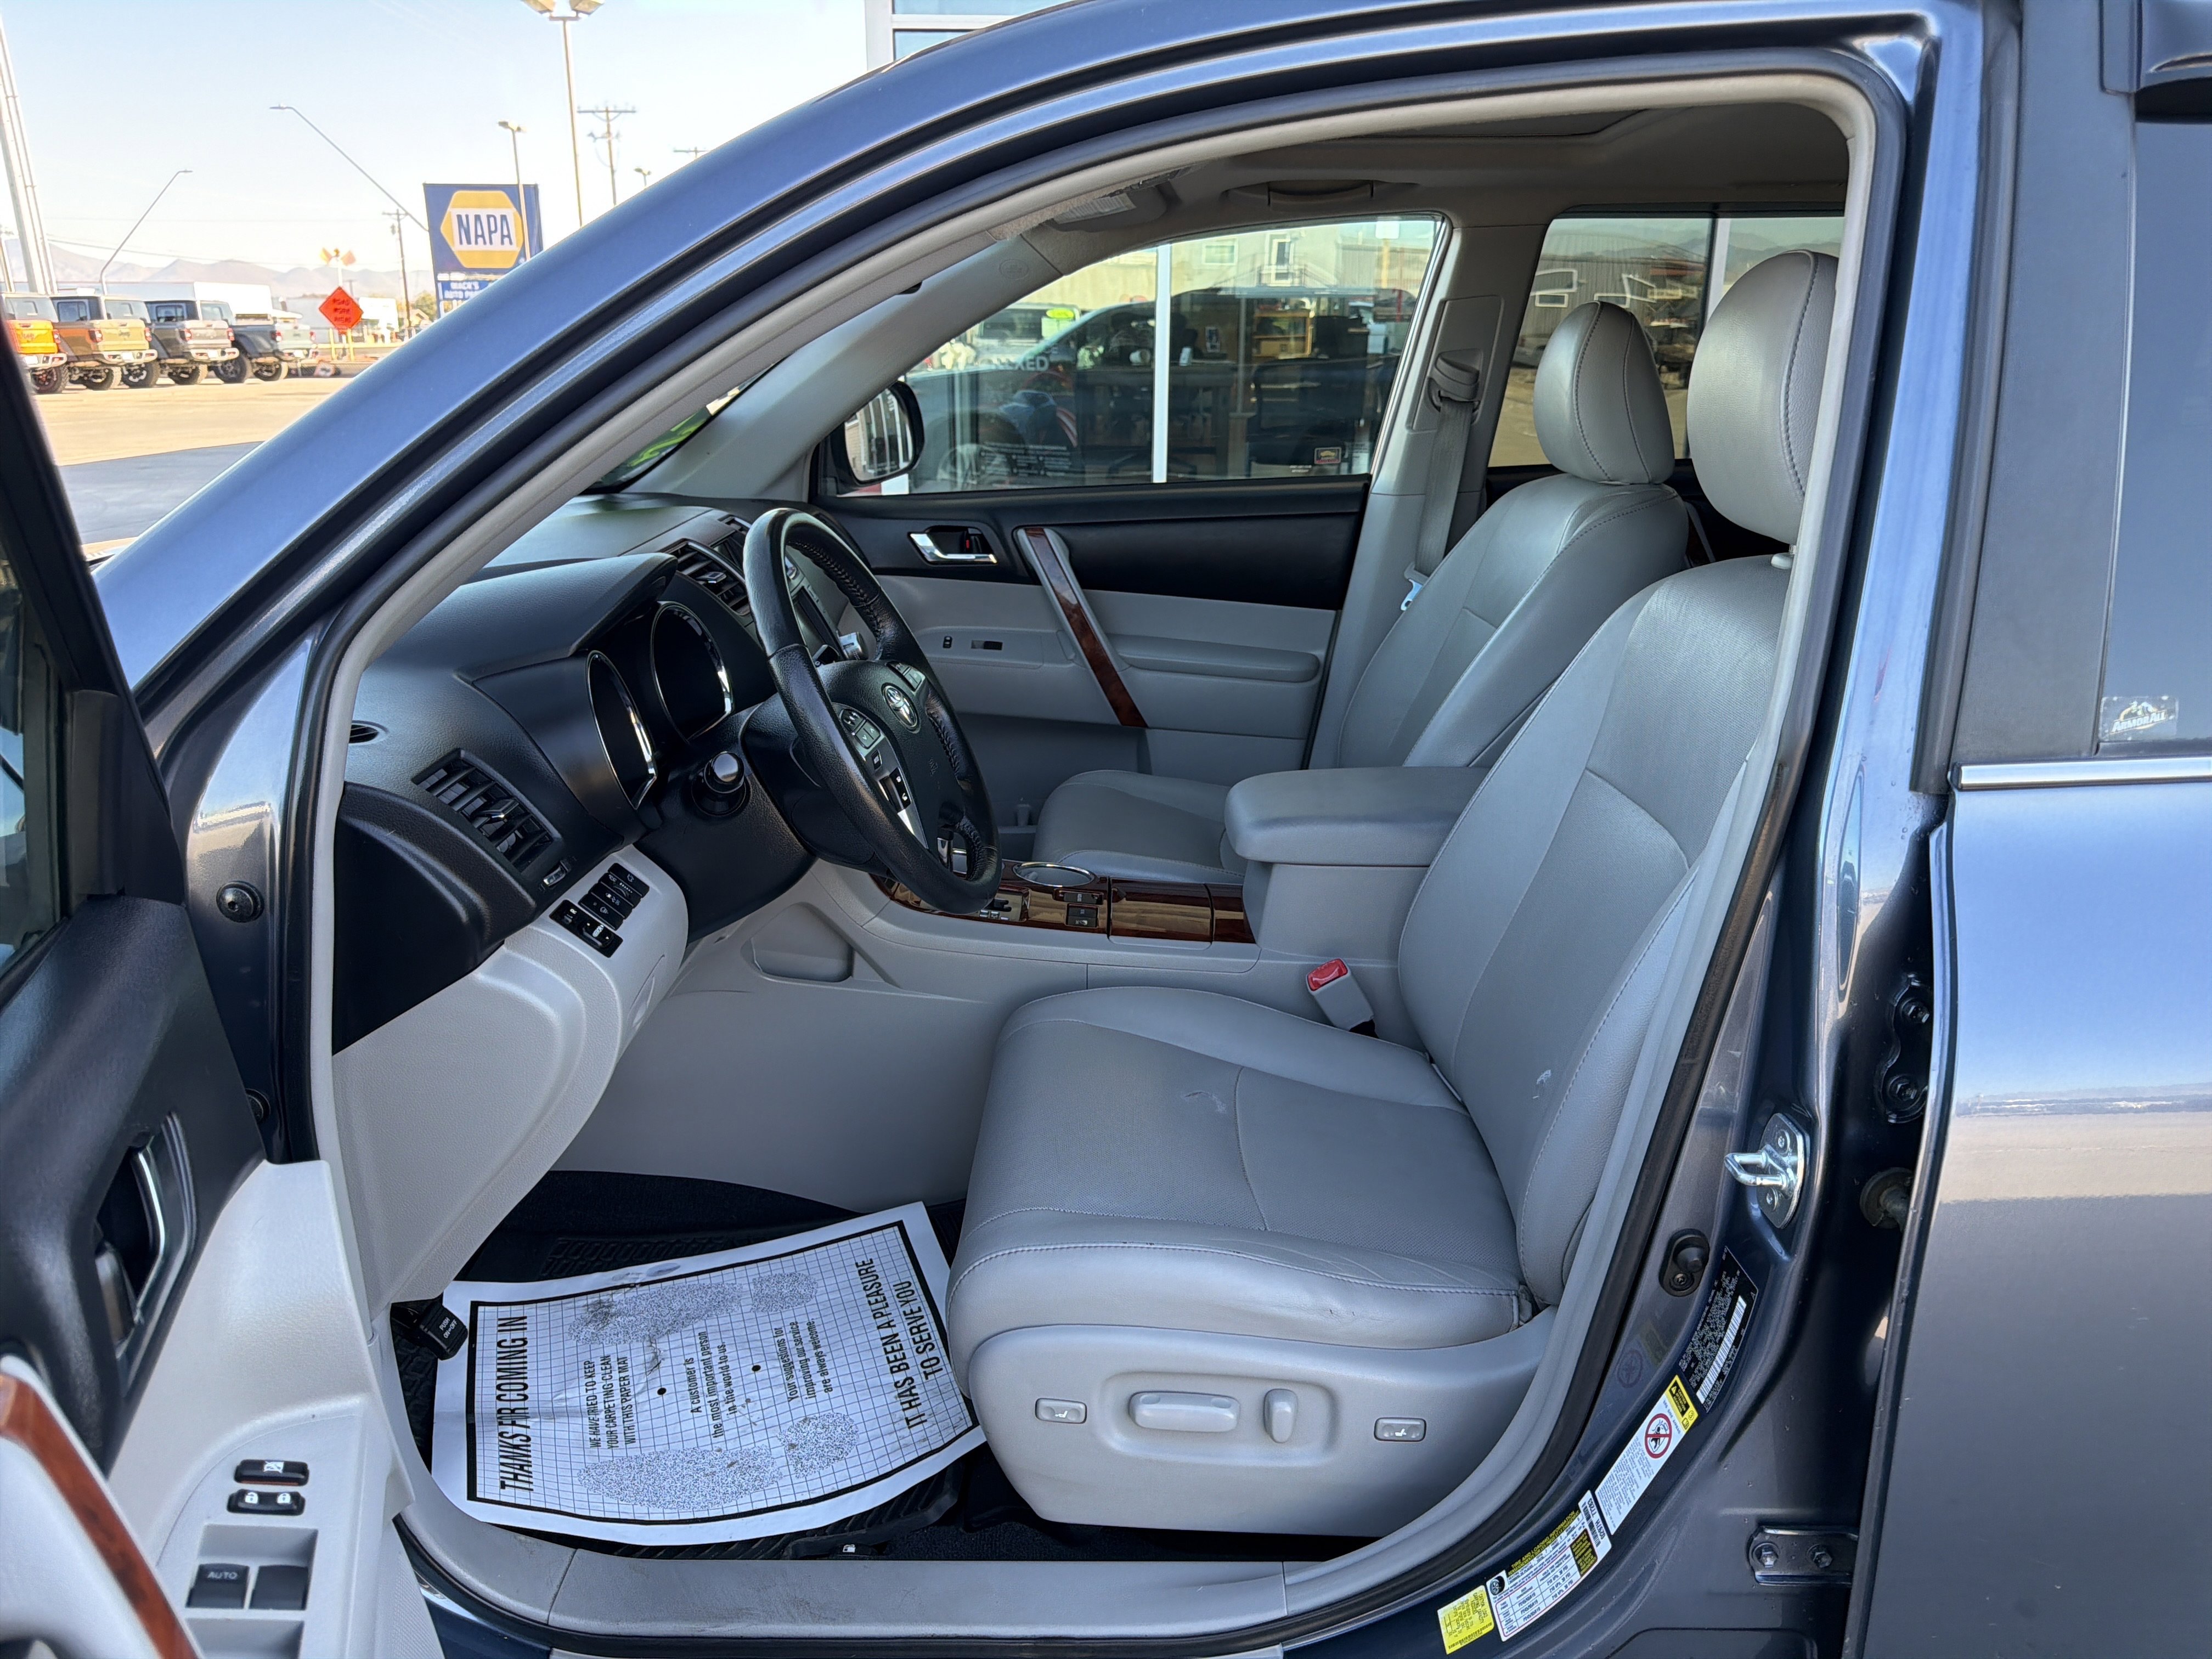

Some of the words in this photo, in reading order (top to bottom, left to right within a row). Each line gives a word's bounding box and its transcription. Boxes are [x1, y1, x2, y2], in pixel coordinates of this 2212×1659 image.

[456, 214, 513, 245] NAPA
[855, 1258, 893, 1320] PLEASURE
[893, 1280, 918, 1308] YOU
[439, 1317, 450, 1331] PUSH
[497, 1316, 528, 1333] IN
[773, 1327, 785, 1338] for
[789, 1321, 804, 1346] service
[877, 1319, 896, 1330] A
[902, 1306, 935, 1355] SERVE
[698, 1331, 713, 1357] person
[795, 1346, 806, 1358] our
[880, 1333, 910, 1375] BEEN
[496, 1337, 529, 1402] COMING
[584, 1360, 596, 1380] KEEP
[600, 1355, 613, 1381] CLEAN
[617, 1356, 629, 1374] MAT
[683, 1357, 695, 1365] is
[718, 1355, 728, 1364] to
[776, 1338, 795, 1381] suggestions
[814, 1351, 829, 1377] always
[920, 1356, 944, 1380] TO
[585, 1380, 597, 1393] TO
[686, 1367, 701, 1405] customer
[701, 1357, 718, 1397] important
[718, 1364, 733, 1388] world
[799, 1358, 817, 1400] improving
[821, 1378, 833, 1393] are
[619, 1374, 632, 1404] PAPER
[725, 1389, 736, 1404] the
[787, 1381, 799, 1402] Your
[894, 1376, 922, 1412] HAS
[586, 1395, 599, 1416] TRIED
[602, 1383, 617, 1429] CARPETING
[620, 1404, 635, 1425] THIS
[690, 1406, 702, 1414] A
[707, 1398, 721, 1421] most
[726, 1404, 738, 1416] in
[496, 1407, 531, 1429] FOR
[588, 1417, 601, 1436] HAVE
[905, 1413, 928, 1430] IT
[606, 1429, 619, 1449] YOUR
[623, 1424, 636, 1445] WITH
[713, 1422, 724, 1438] the
[589, 1437, 602, 1448] WE
[498, 1431, 534, 1492] THANKS
[1511, 1559, 1522, 1569] TIRE
[1522, 1551, 1532, 1561] AND
[1531, 1536, 1549, 1554] LOADING
[1549, 1510, 1575, 1538] INFORMATION
[207, 1571, 238, 1579] AUTO
